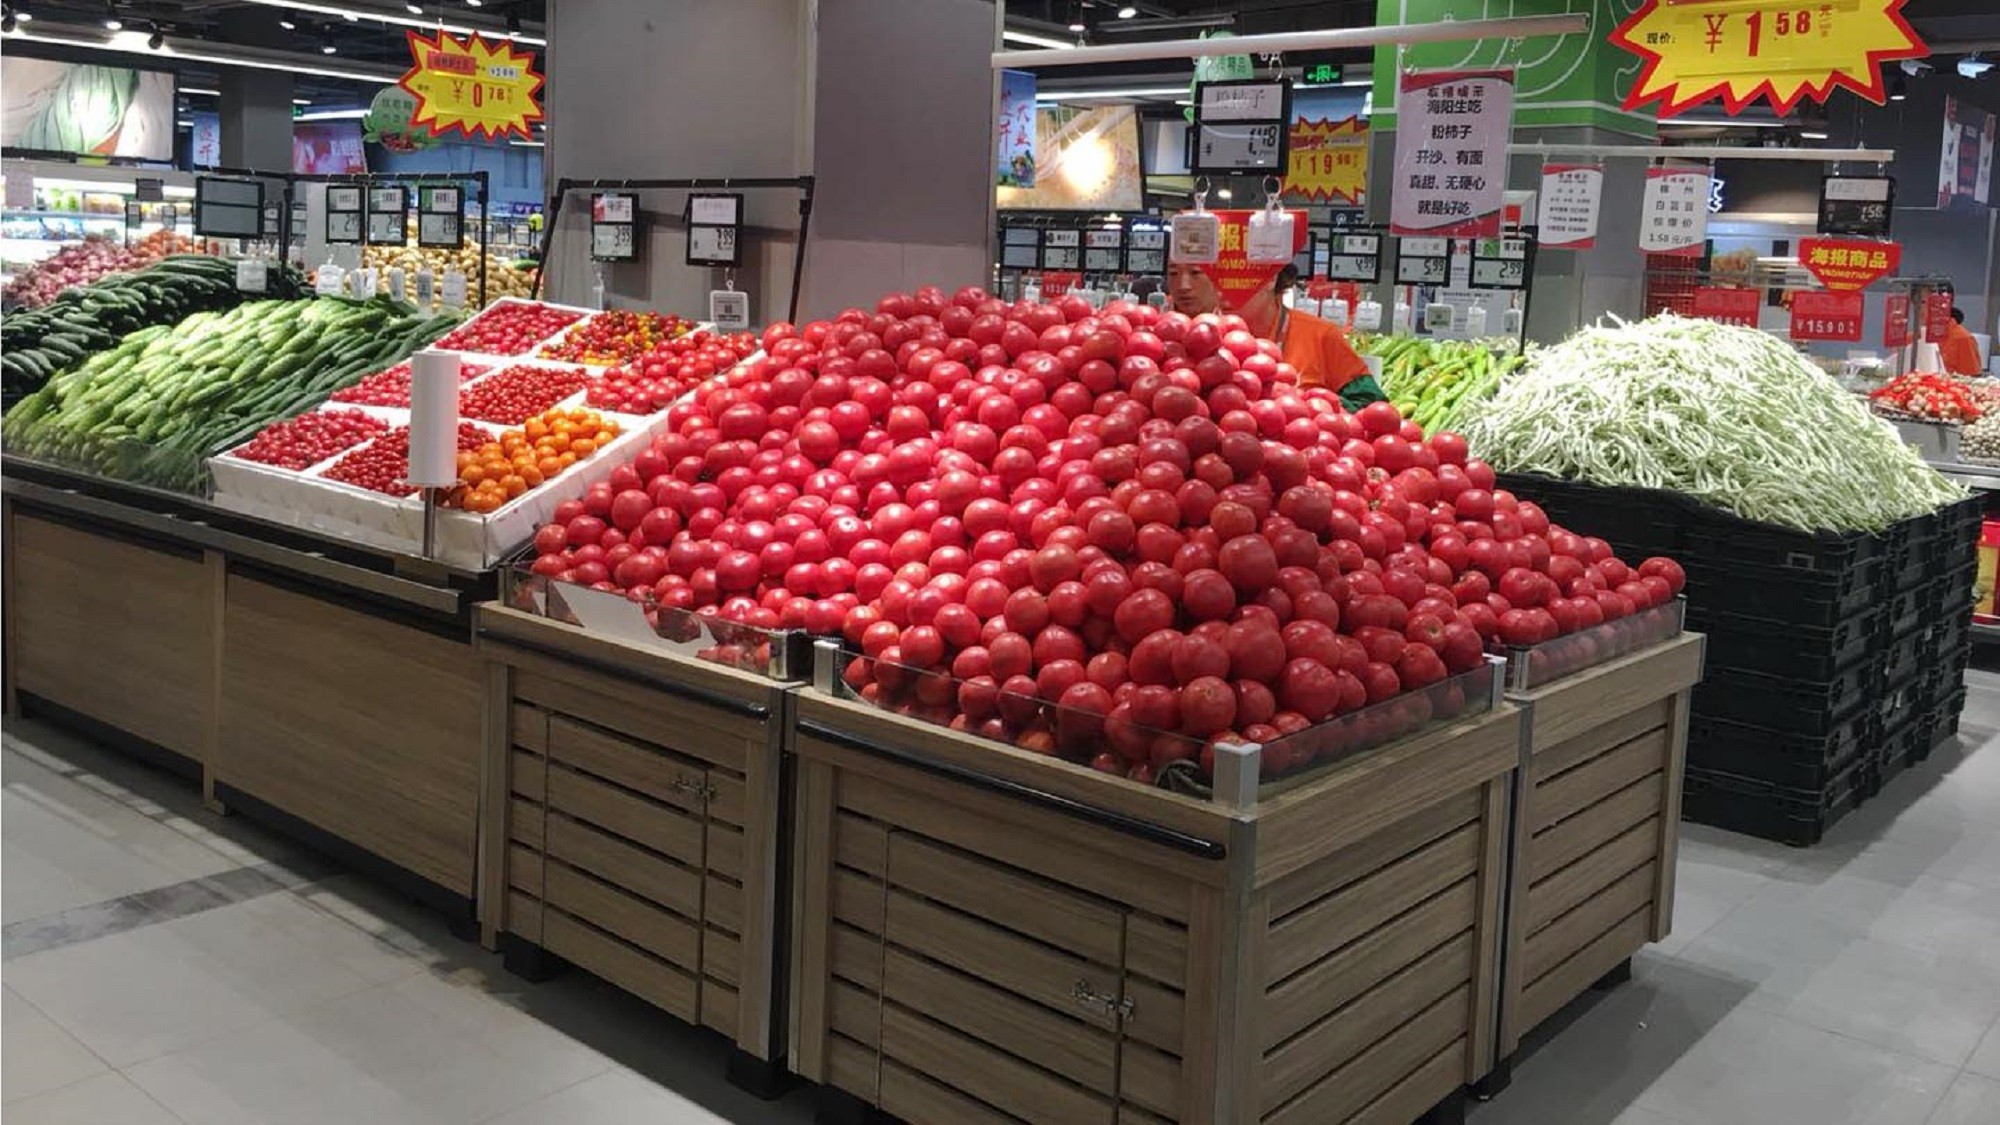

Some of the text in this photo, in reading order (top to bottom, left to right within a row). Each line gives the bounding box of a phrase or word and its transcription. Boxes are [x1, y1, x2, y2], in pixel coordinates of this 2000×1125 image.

[1427, 99, 1482, 114] 海阳生吃
[1431, 124, 1472, 139] 粉柿子
[1417, 200, 1471, 215] 就是好吃
[1809, 247, 1888, 269] 海报商品
